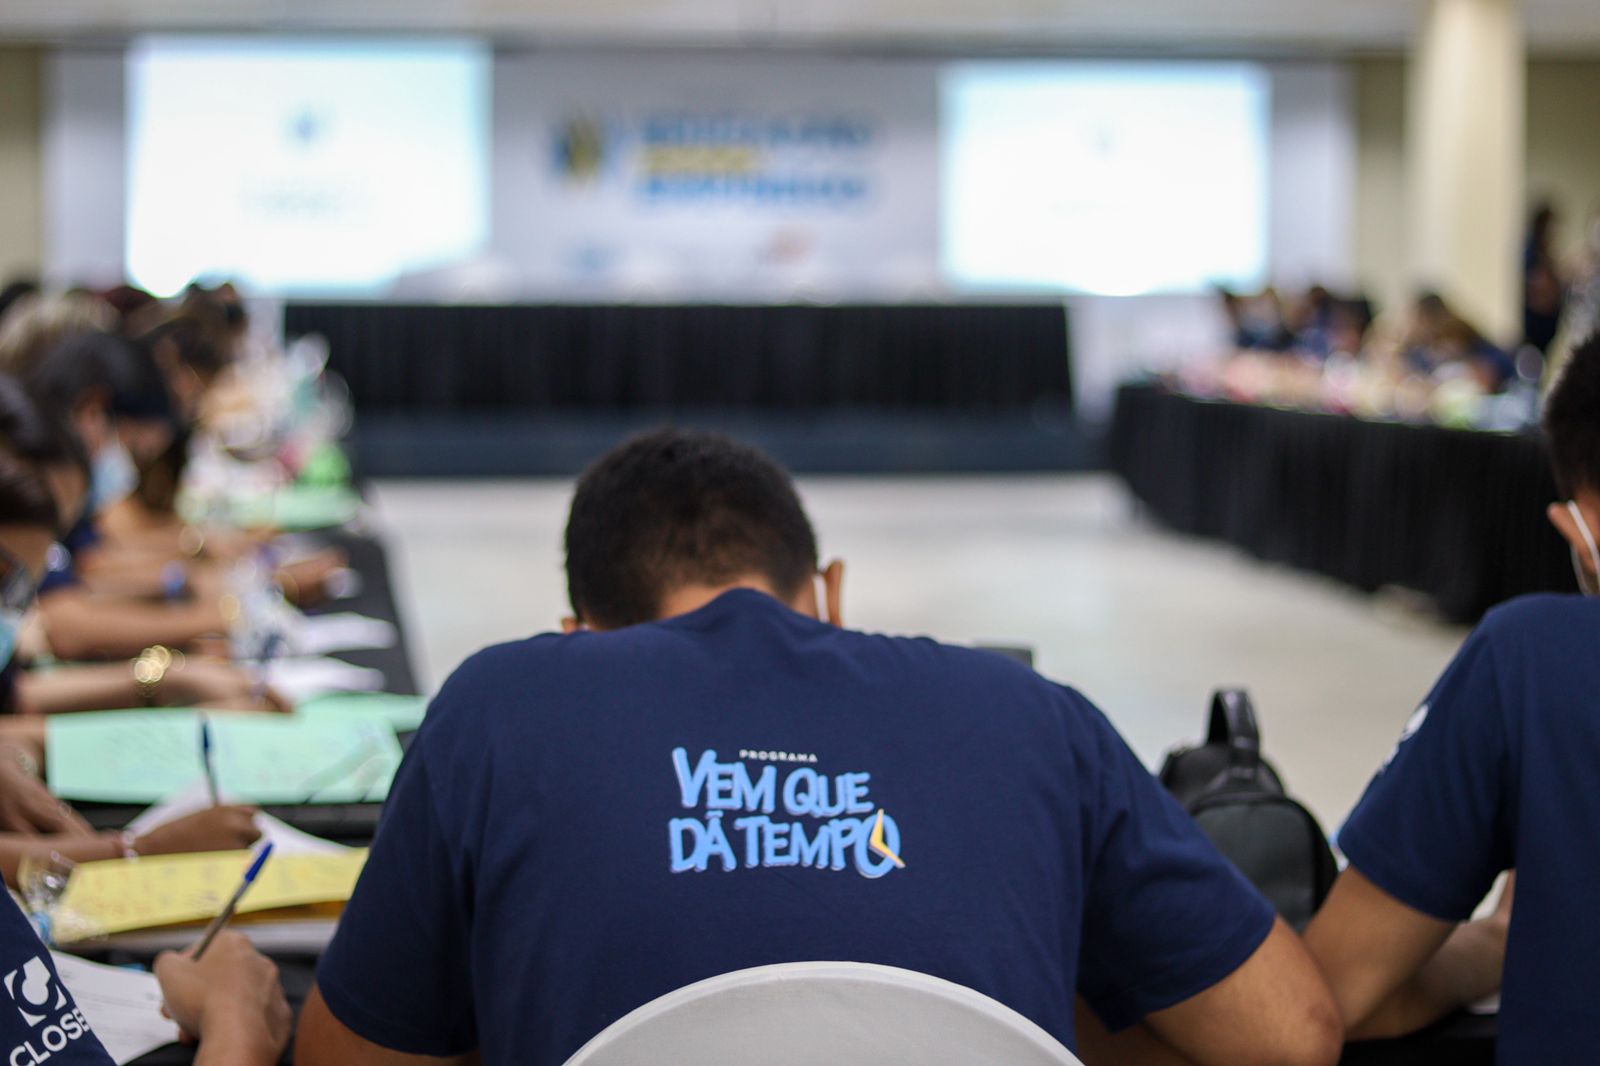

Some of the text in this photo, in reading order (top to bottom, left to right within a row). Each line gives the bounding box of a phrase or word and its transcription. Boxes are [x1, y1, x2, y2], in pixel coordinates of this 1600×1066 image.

[672, 747, 875, 818] VEM QUE
[738, 749, 818, 763] PROGRAMA
[734, 808, 906, 879] TEMPO
